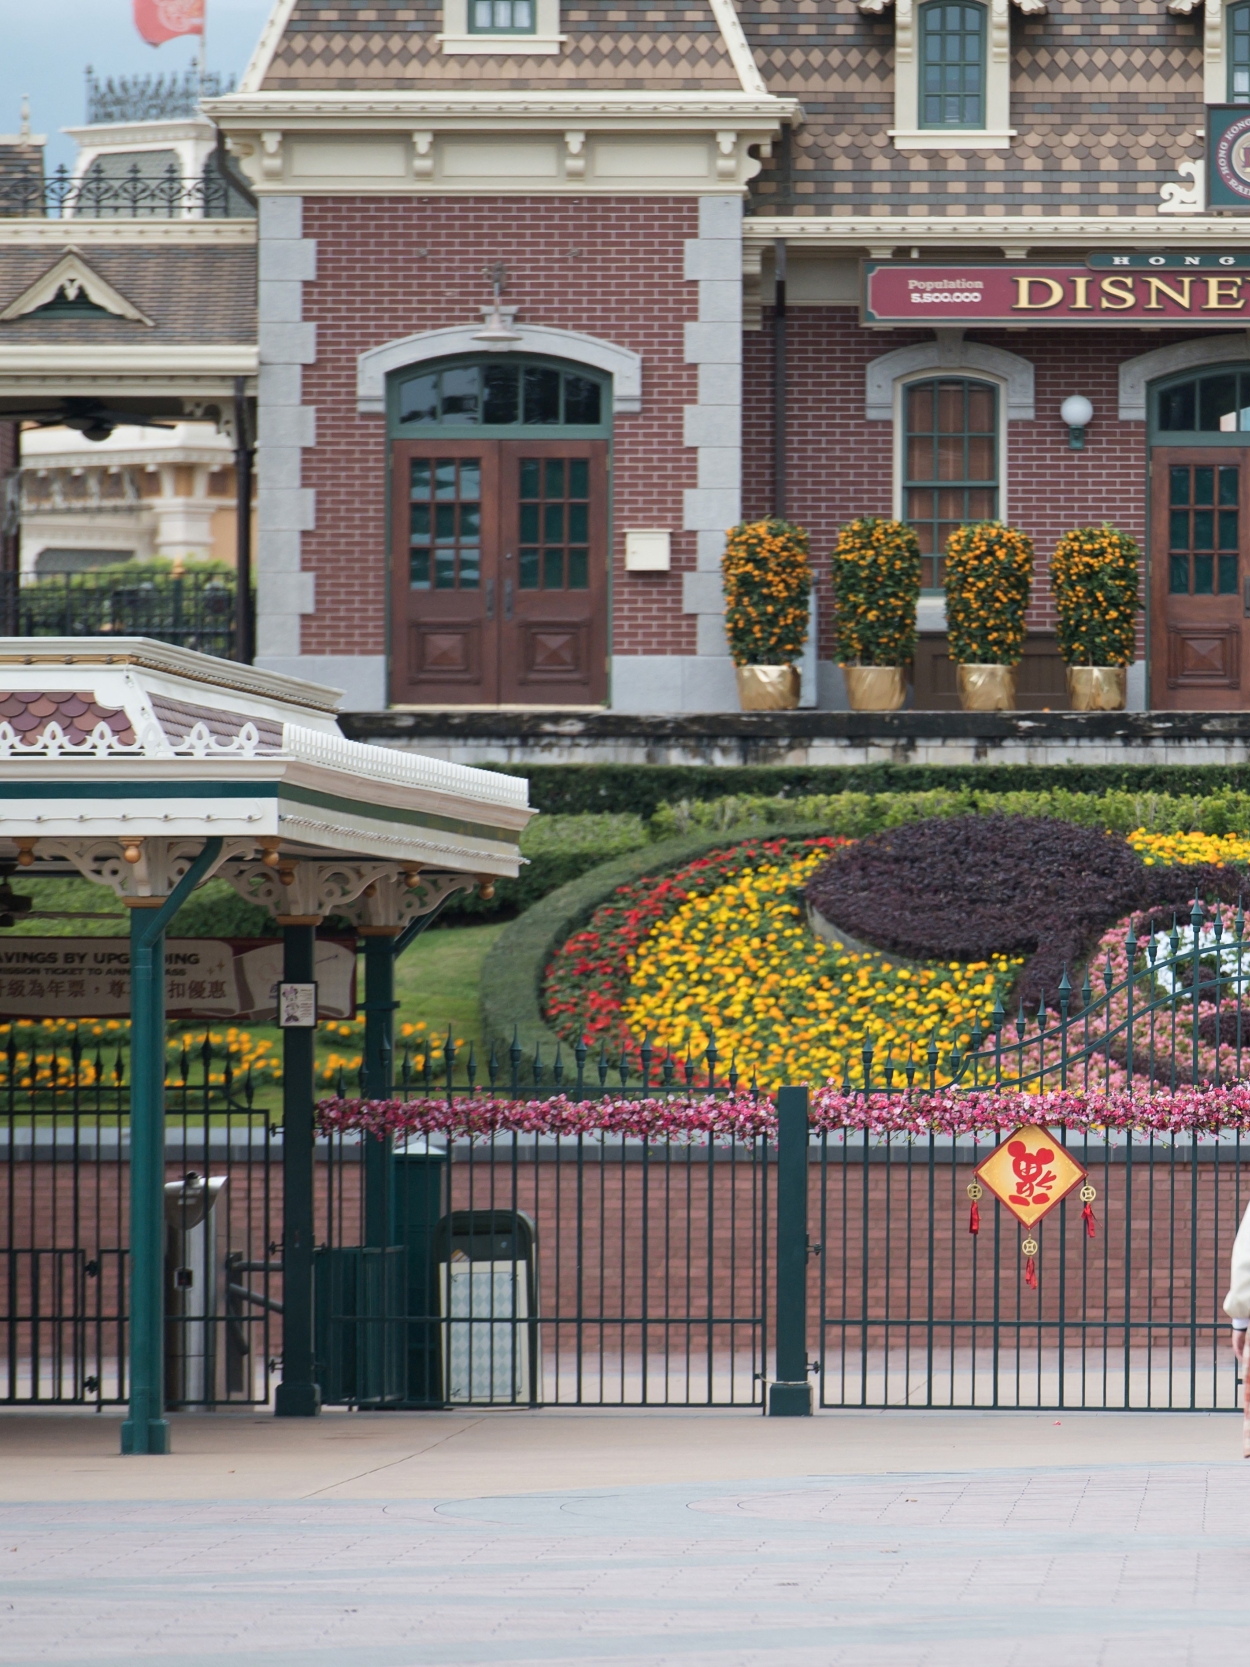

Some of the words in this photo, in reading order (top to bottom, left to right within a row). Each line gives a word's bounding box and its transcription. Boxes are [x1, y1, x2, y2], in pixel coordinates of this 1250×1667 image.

[1218, 141, 1229, 176] HONG
[1112, 256, 1236, 265] HONG
[908, 279, 984, 291] Population
[0, 952, 58, 964] VINGS
[63, 952, 88, 964] BY
[44, 967, 85, 976] TICKET
[87, 967, 103, 976] TO
